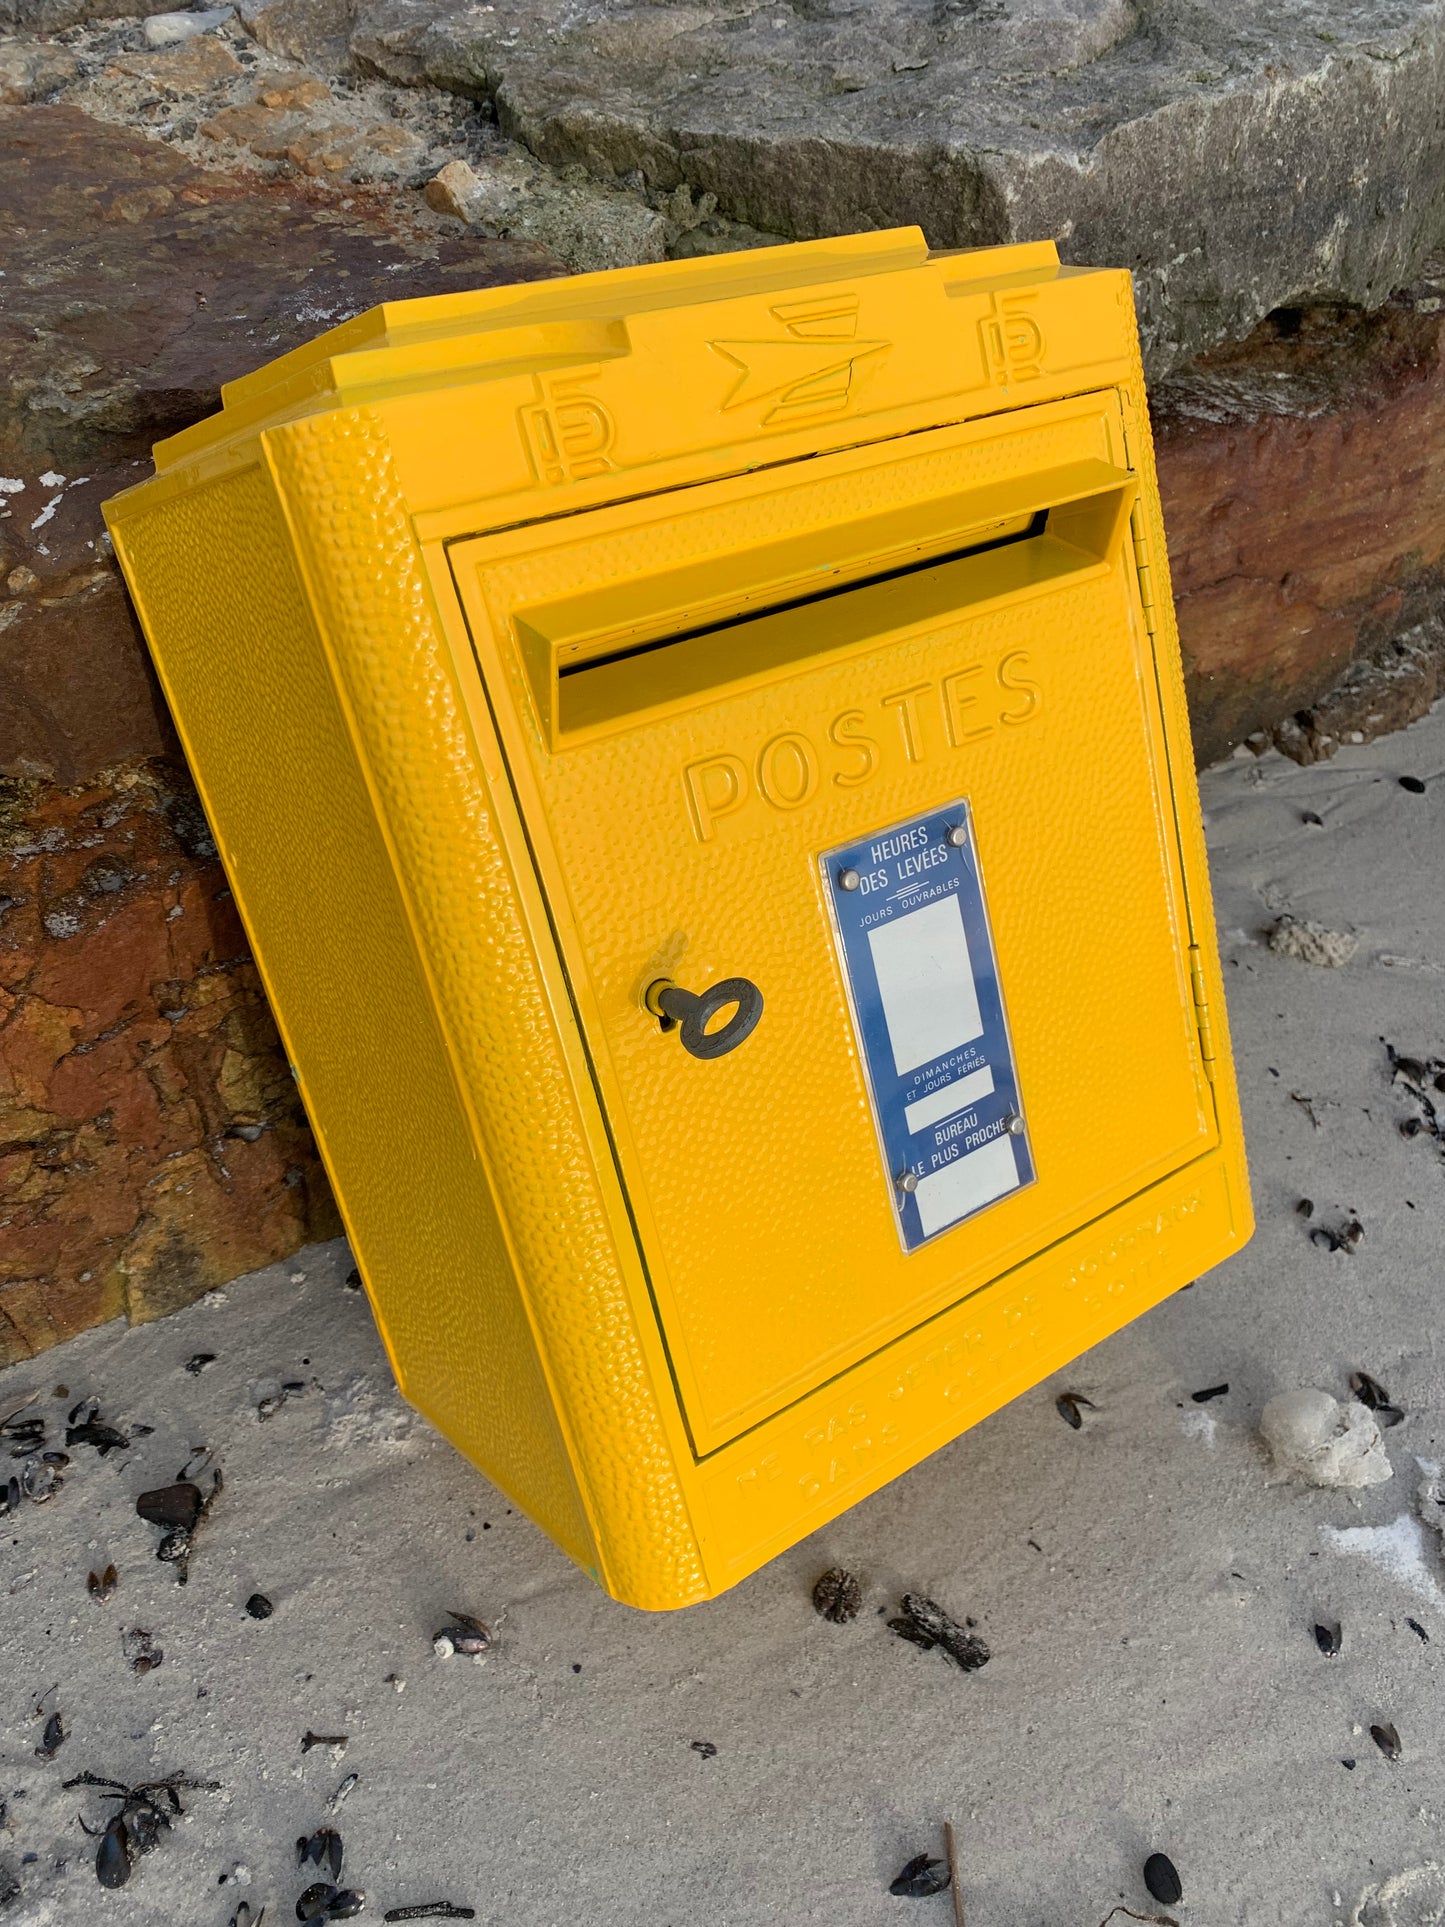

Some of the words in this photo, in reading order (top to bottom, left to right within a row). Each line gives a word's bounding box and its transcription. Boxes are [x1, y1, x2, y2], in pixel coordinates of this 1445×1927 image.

[682, 650, 1042, 842] POSTES
[859, 869, 888, 896] DES
[897, 844, 948, 880] LEVÉES
[871, 826, 929, 865] HEURES
[859, 906, 893, 928] JOURS
[901, 877, 961, 909] OUVRABLES
[906, 1089, 917, 1101] ET
[923, 1072, 952, 1093] JOURS
[914, 1047, 977, 1085] DIMANCHES
[931, 1143, 960, 1168] PLUS
[965, 1116, 1006, 1150] PROCHE
[935, 1113, 979, 1146] BUREAU
[803, 1401, 867, 1457] PAS
